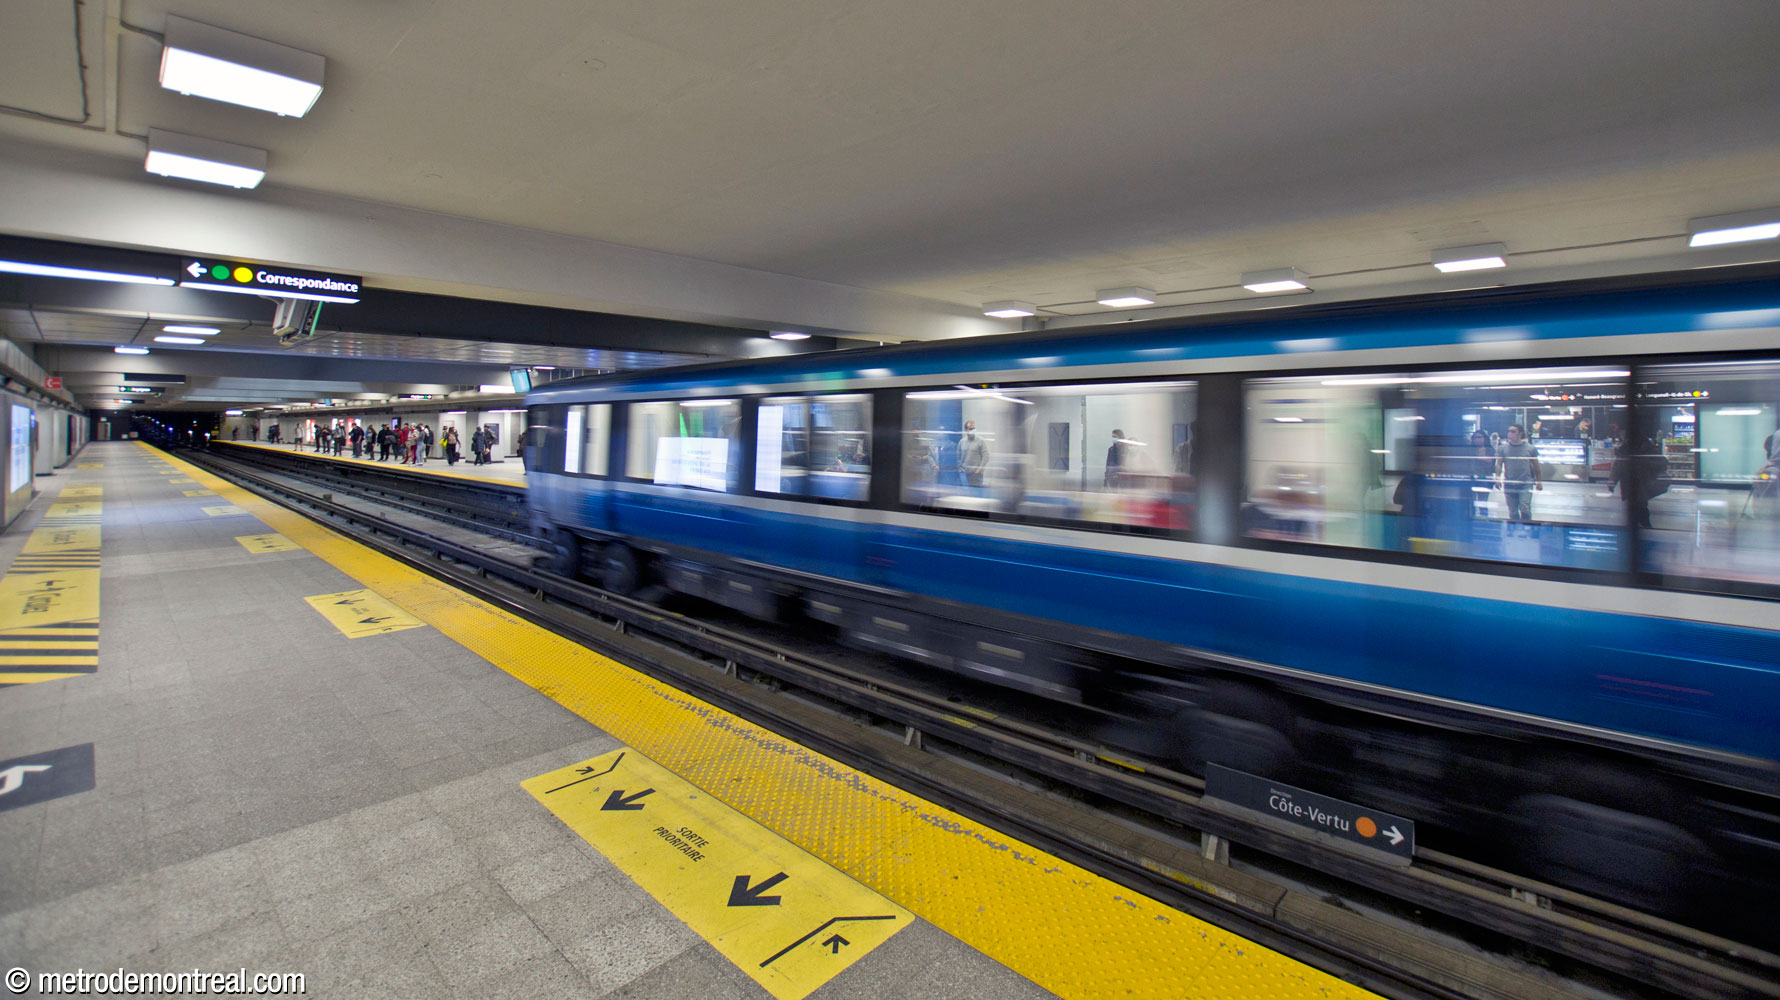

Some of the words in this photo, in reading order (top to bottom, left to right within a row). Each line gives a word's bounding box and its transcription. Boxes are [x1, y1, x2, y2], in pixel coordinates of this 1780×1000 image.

[256, 270, 359, 293] Correspondance
[1270, 787, 1292, 799] Direction
[1269, 795, 1350, 832] Côte-Vertu
[652, 826, 706, 863] PRIORITAIRE
[676, 826, 710, 848] SORTIE
